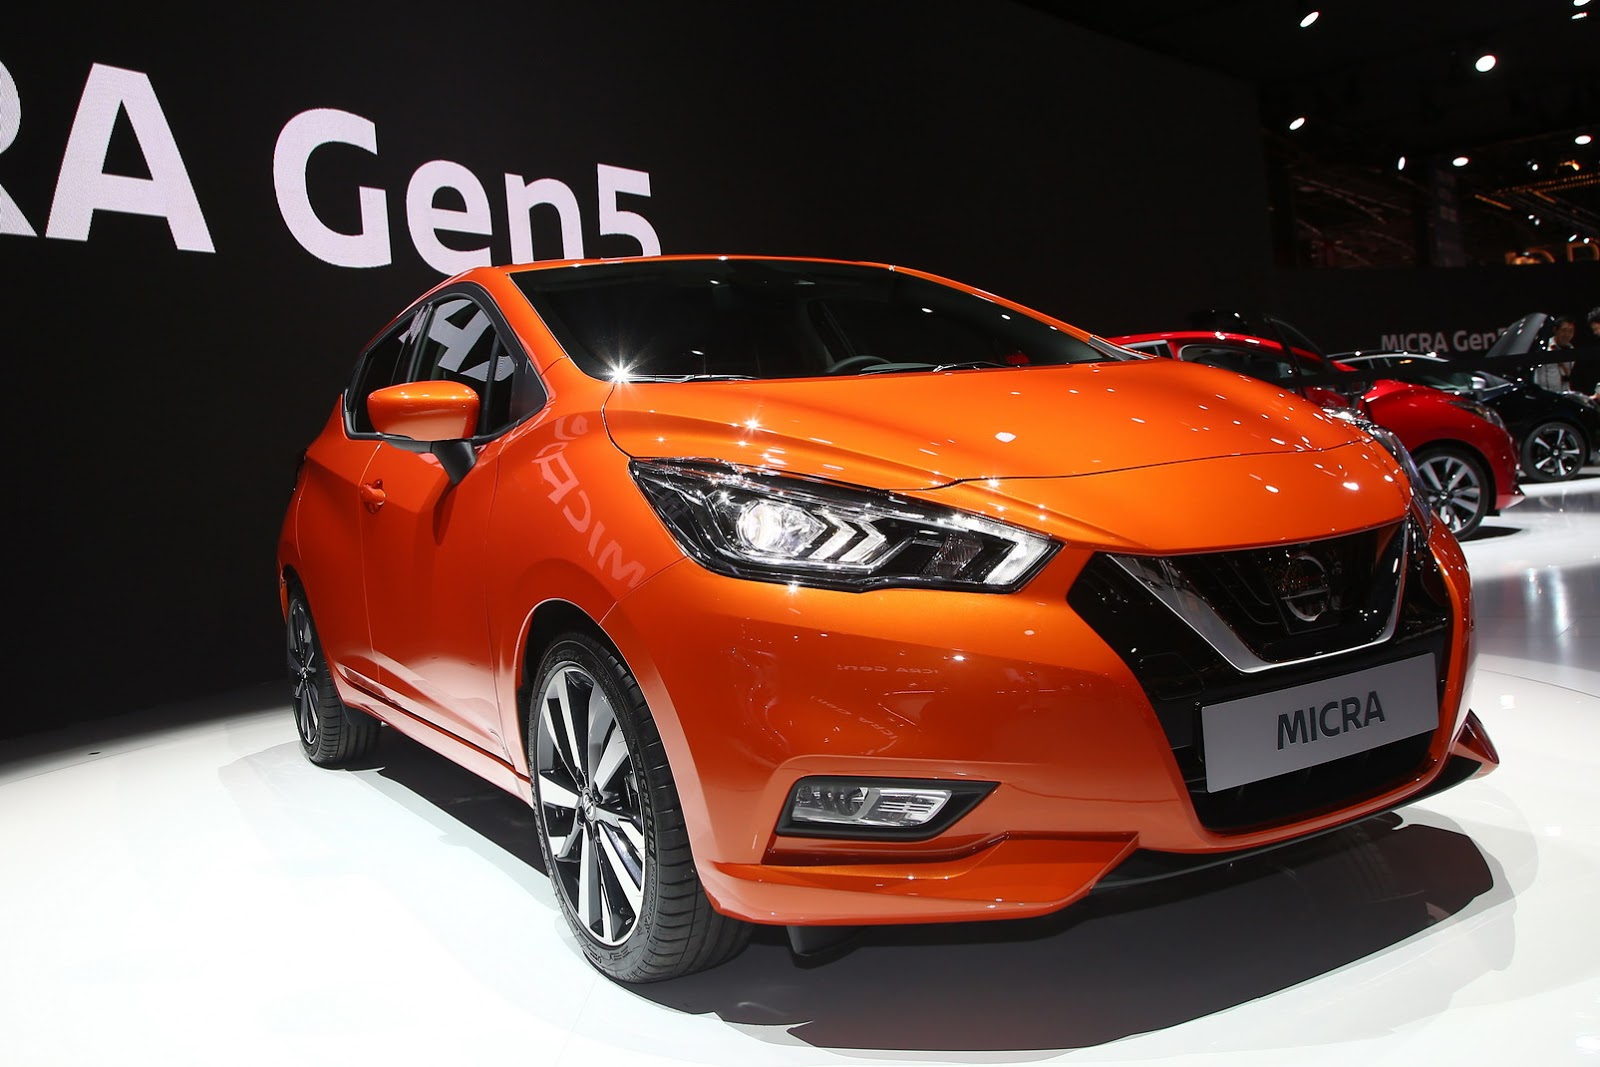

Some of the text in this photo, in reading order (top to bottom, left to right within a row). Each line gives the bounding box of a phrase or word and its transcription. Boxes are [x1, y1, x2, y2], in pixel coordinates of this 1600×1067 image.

[0, 60, 216, 254] A
[1381, 327, 1509, 353] MICRA Gen
[1276, 690, 1386, 751] MICRA
[634, 752, 656, 855] MICHELIN
